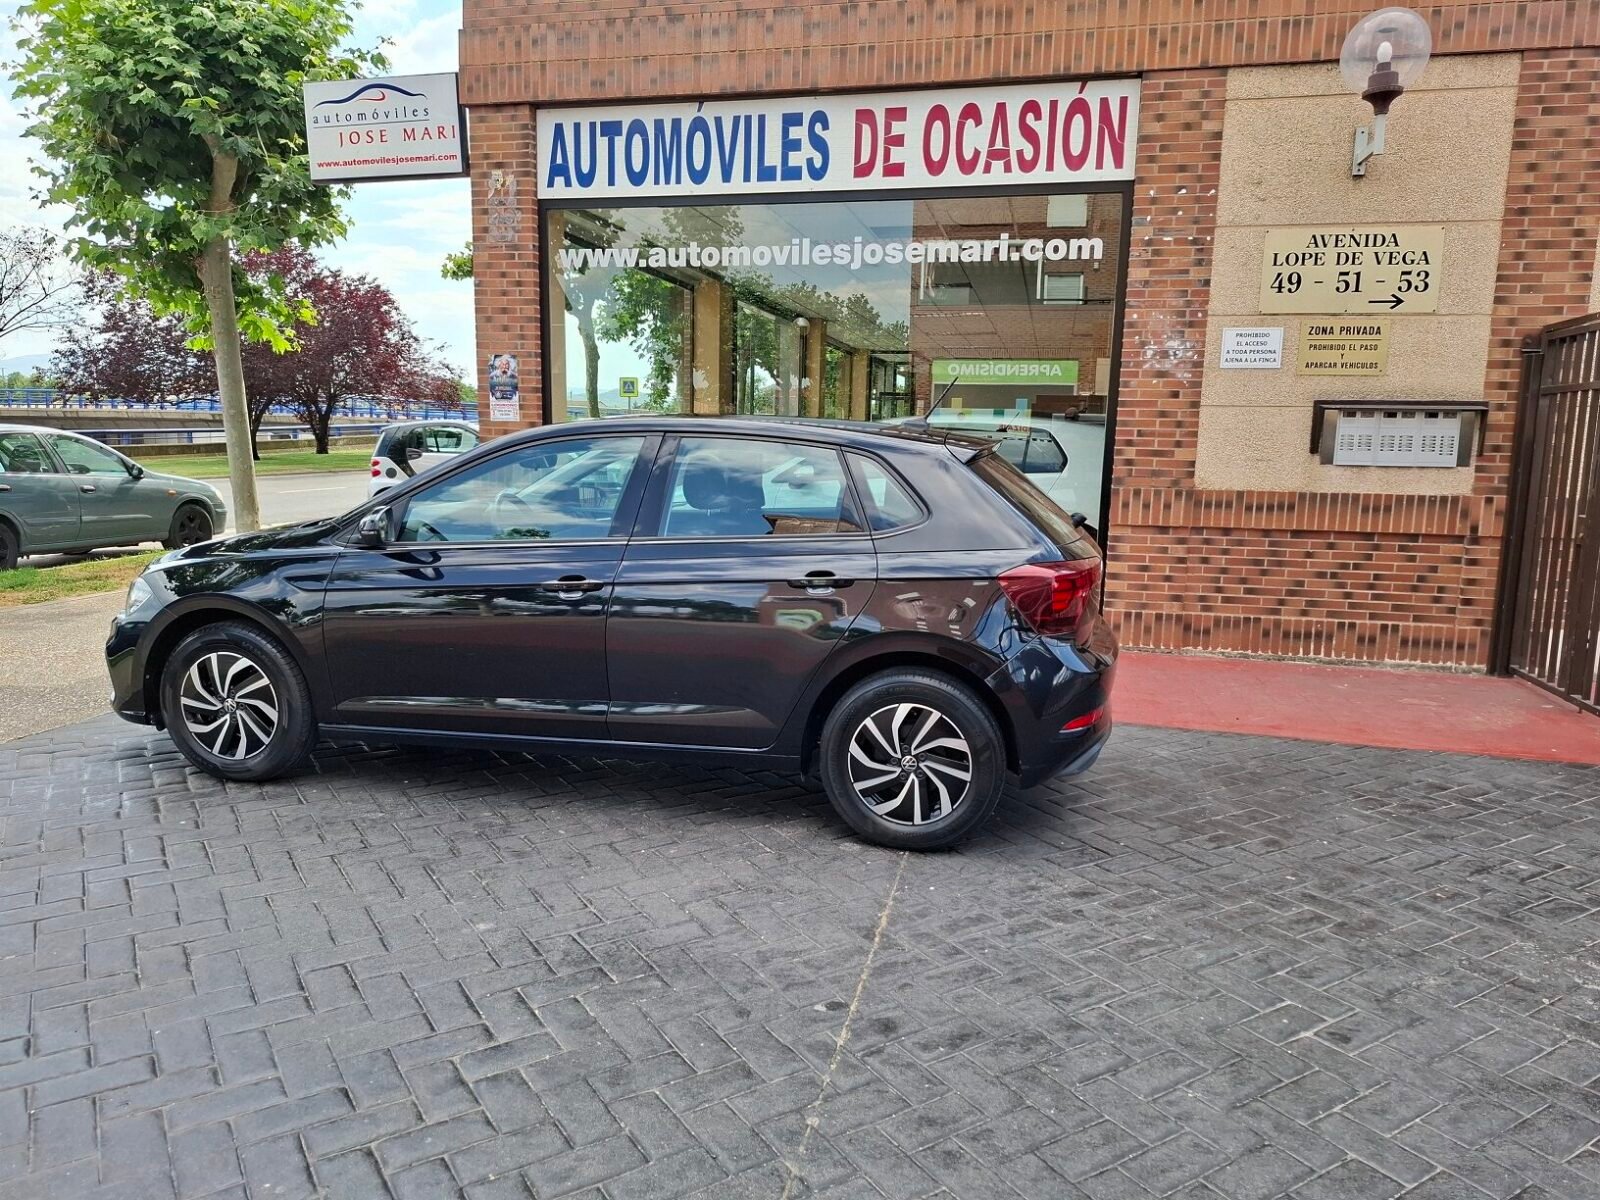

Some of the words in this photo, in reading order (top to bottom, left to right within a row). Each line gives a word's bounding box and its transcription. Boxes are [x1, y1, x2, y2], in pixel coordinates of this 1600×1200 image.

[313, 106, 430, 124] automóviles
[338, 129, 388, 148] JOSE
[403, 125, 456, 142] MARI
[546, 101, 831, 189] AUTOMÓVILES
[853, 106, 908, 179] DE
[922, 81, 1130, 175] OCASIÓN
[316, 153, 458, 168] www.automovilesjosemari.com
[1305, 232, 1400, 249] AVENIDA
[558, 232, 1105, 270] www.automovilesjosemari.com
[1272, 251, 1326, 267] LOPE
[1335, 251, 1363, 266] DE
[1373, 250, 1431, 266] VEGA
[1270, 271, 1303, 294] 49
[1335, 271, 1363, 294] 51
[1397, 270, 1430, 293] 53
[1308, 326, 1335, 336] ZONA
[1339, 326, 1382, 336] PRIVADA
